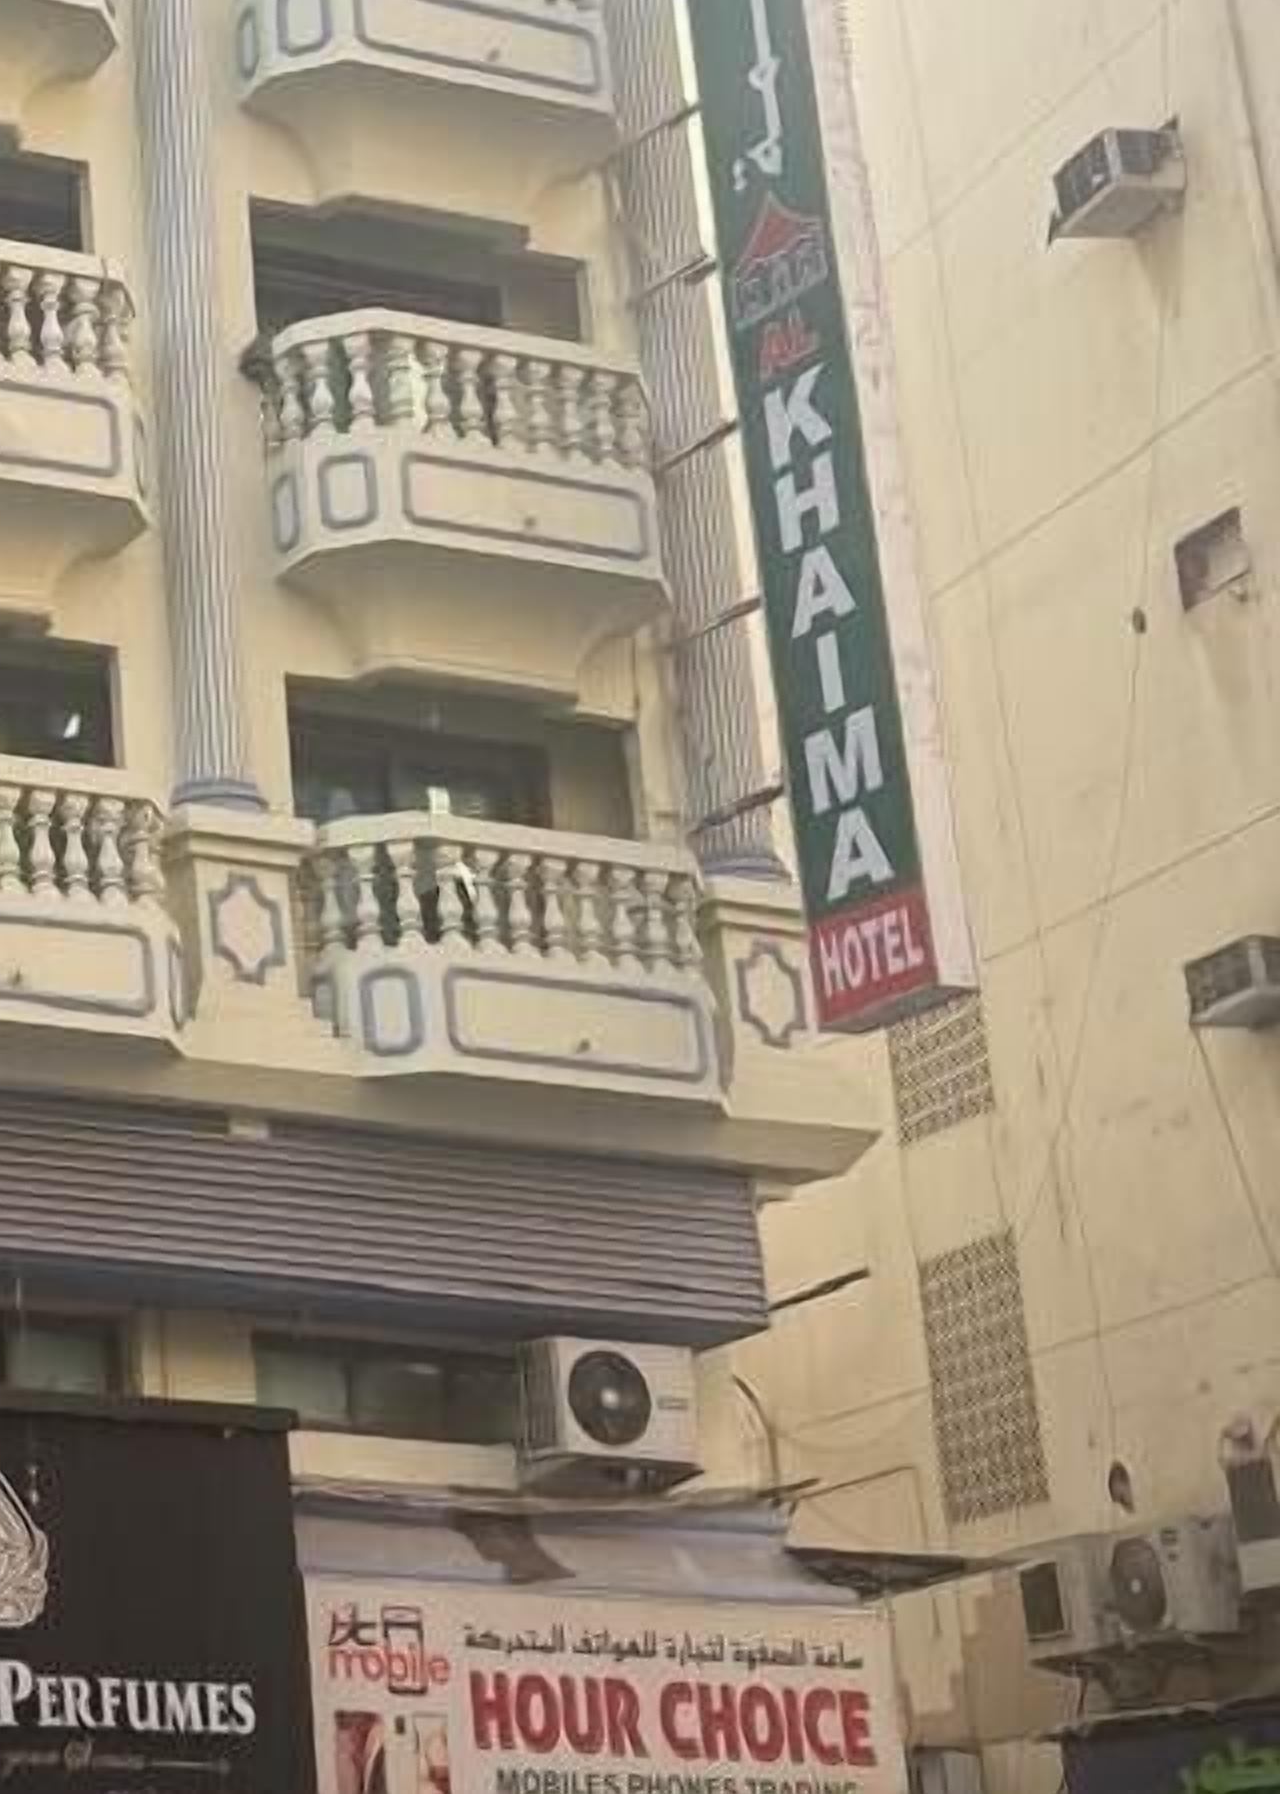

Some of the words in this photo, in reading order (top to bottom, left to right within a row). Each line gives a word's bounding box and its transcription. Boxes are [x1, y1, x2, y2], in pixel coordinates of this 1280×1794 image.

[762, 361, 897, 903] KHAIMA
[818, 906, 925, 999] HOTEL
[468, 1669, 648, 1759] HOUR
[658, 1680, 878, 1767] CHOICE
